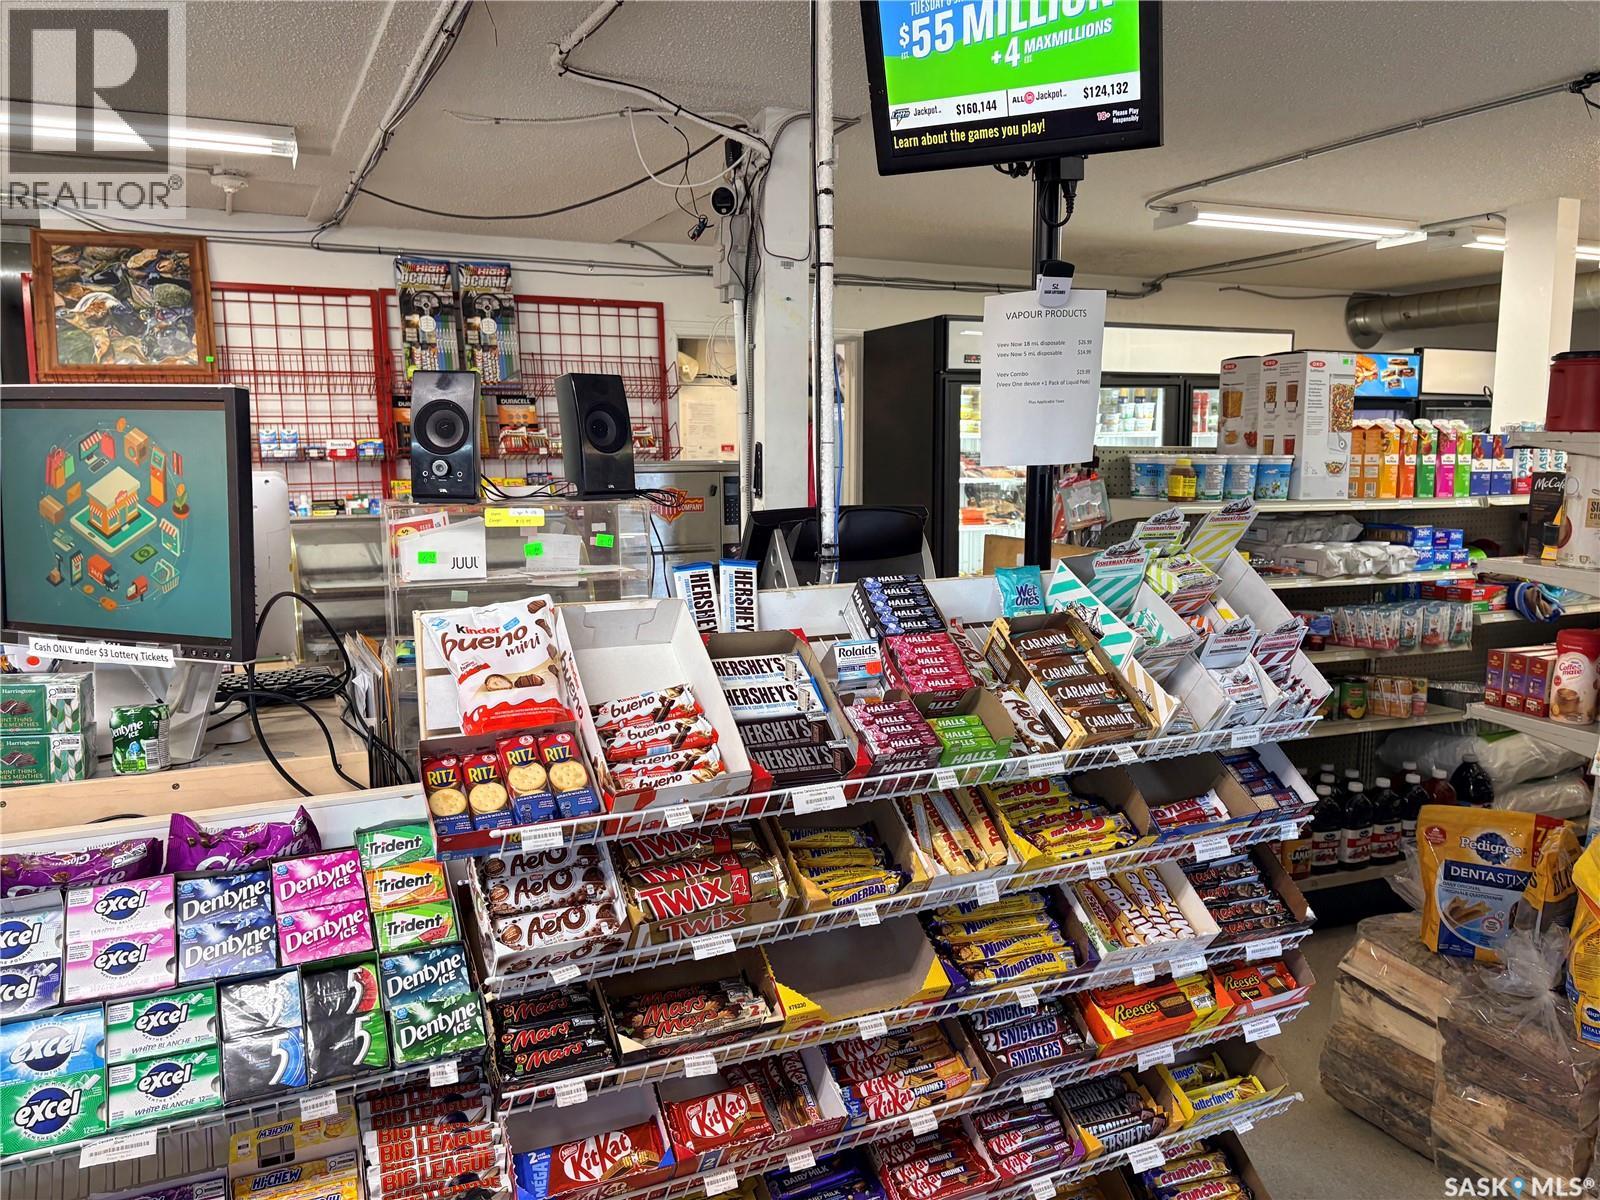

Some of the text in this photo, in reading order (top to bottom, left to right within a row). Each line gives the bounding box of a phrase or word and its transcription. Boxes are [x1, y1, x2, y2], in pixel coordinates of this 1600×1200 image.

[963, 0, 1113, 46] MILLI
[1024, 18, 1112, 54] MAXMILLIONS
[1036, 82, 1128, 100] Jackpot $124,132
[914, 106, 938, 117] Jackpot
[956, 100, 997, 116] $160,144
[894, 119, 1045, 149] Learn about the games you play!
[401, 272, 448, 286] OCTANE
[415, 264, 446, 274] HIGH
[477, 267, 507, 276] HIGH
[463, 275, 507, 288] OCTANE
[1005, 308, 1087, 320] VAPOUR PRODUCTS
[500, 398, 531, 406] DURACELL
[451, 556, 479, 570] JUUL
[1015, 585, 1038, 598] Wet
[1015, 594, 1040, 606] Ones
[456, 624, 500, 634] kinder
[34, 642, 169, 662] Cash ONLY under $3 Lottery Tickets
[441, 625, 528, 662] bueno
[505, 633, 541, 658] mini
[838, 645, 877, 658] Rolaids
[1020, 633, 1070, 650] CARAMILK
[715, 657, 786, 677] HERSHEY'S
[1042, 663, 1088, 681] CARAMILK
[726, 684, 798, 707] HERSHEY'S
[1057, 683, 1107, 700] CARAMILK
[610, 696, 655, 718] bueno
[875, 715, 906, 725] HALLS
[883, 724, 912, 734] HALLS
[938, 718, 966, 728] HALLS
[1085, 712, 1135, 729] CARAMILK
[627, 722, 671, 741] bueno
[545, 744, 572, 762] RITZ
[890, 738, 921, 748] HALLS
[506, 747, 536, 765] RITZ
[755, 745, 833, 771] HERSHEY'S
[952, 751, 996, 765] HALLS
[427, 769, 456, 785] RITZ
[468, 765, 497, 781] RITZ
[367, 836, 422, 855] Trident
[1460, 836, 1522, 856] Pedigree
[279, 859, 357, 902] Dentyne
[375, 873, 432, 893] Trident
[1450, 866, 1527, 888] DENTASTIX
[94, 890, 148, 916] excel
[182, 880, 265, 923] Dentyne ICE
[285, 909, 365, 954] Dentyne ICE
[384, 915, 443, 936] Trident
[94, 943, 148, 971] excel
[185, 924, 271, 969] Dentyne ICE
[386, 952, 462, 998] Dentyne ICE
[994, 952, 1056, 983] WUNDERBAR
[347, 966, 365, 1015] 5
[135, 1003, 189, 1032] excel
[400, 1001, 476, 1048] Dentyne ICE
[352, 1017, 372, 1066] 5
[512, 1019, 571, 1051] Mars
[998, 1018, 1057, 1047] SNICKERS
[9, 1023, 86, 1065] excel
[158, 1037, 192, 1050] BLANCHE
[526, 1042, 583, 1071] Mars
[1010, 1042, 1063, 1067] SNICKERS
[137, 1063, 193, 1093] excel
[14, 1089, 83, 1129] excel
[161, 1098, 196, 1111] BLANCHE
[872, 1080, 946, 1119] KitKat CHUNKY
[697, 1092, 747, 1137] KitKat
[381, 1129, 493, 1163] BIG LEAGUE
[567, 1130, 628, 1181] KitKat
[252, 1168, 302, 1190] HI-CHEW
[382, 1149, 496, 1194] BIG LEAGUE
[782, 1165, 829, 1187] DAIRY MILK
[940, 1166, 965, 1178] CHUNKY
[1160, 1159, 1213, 1186] crunchie
